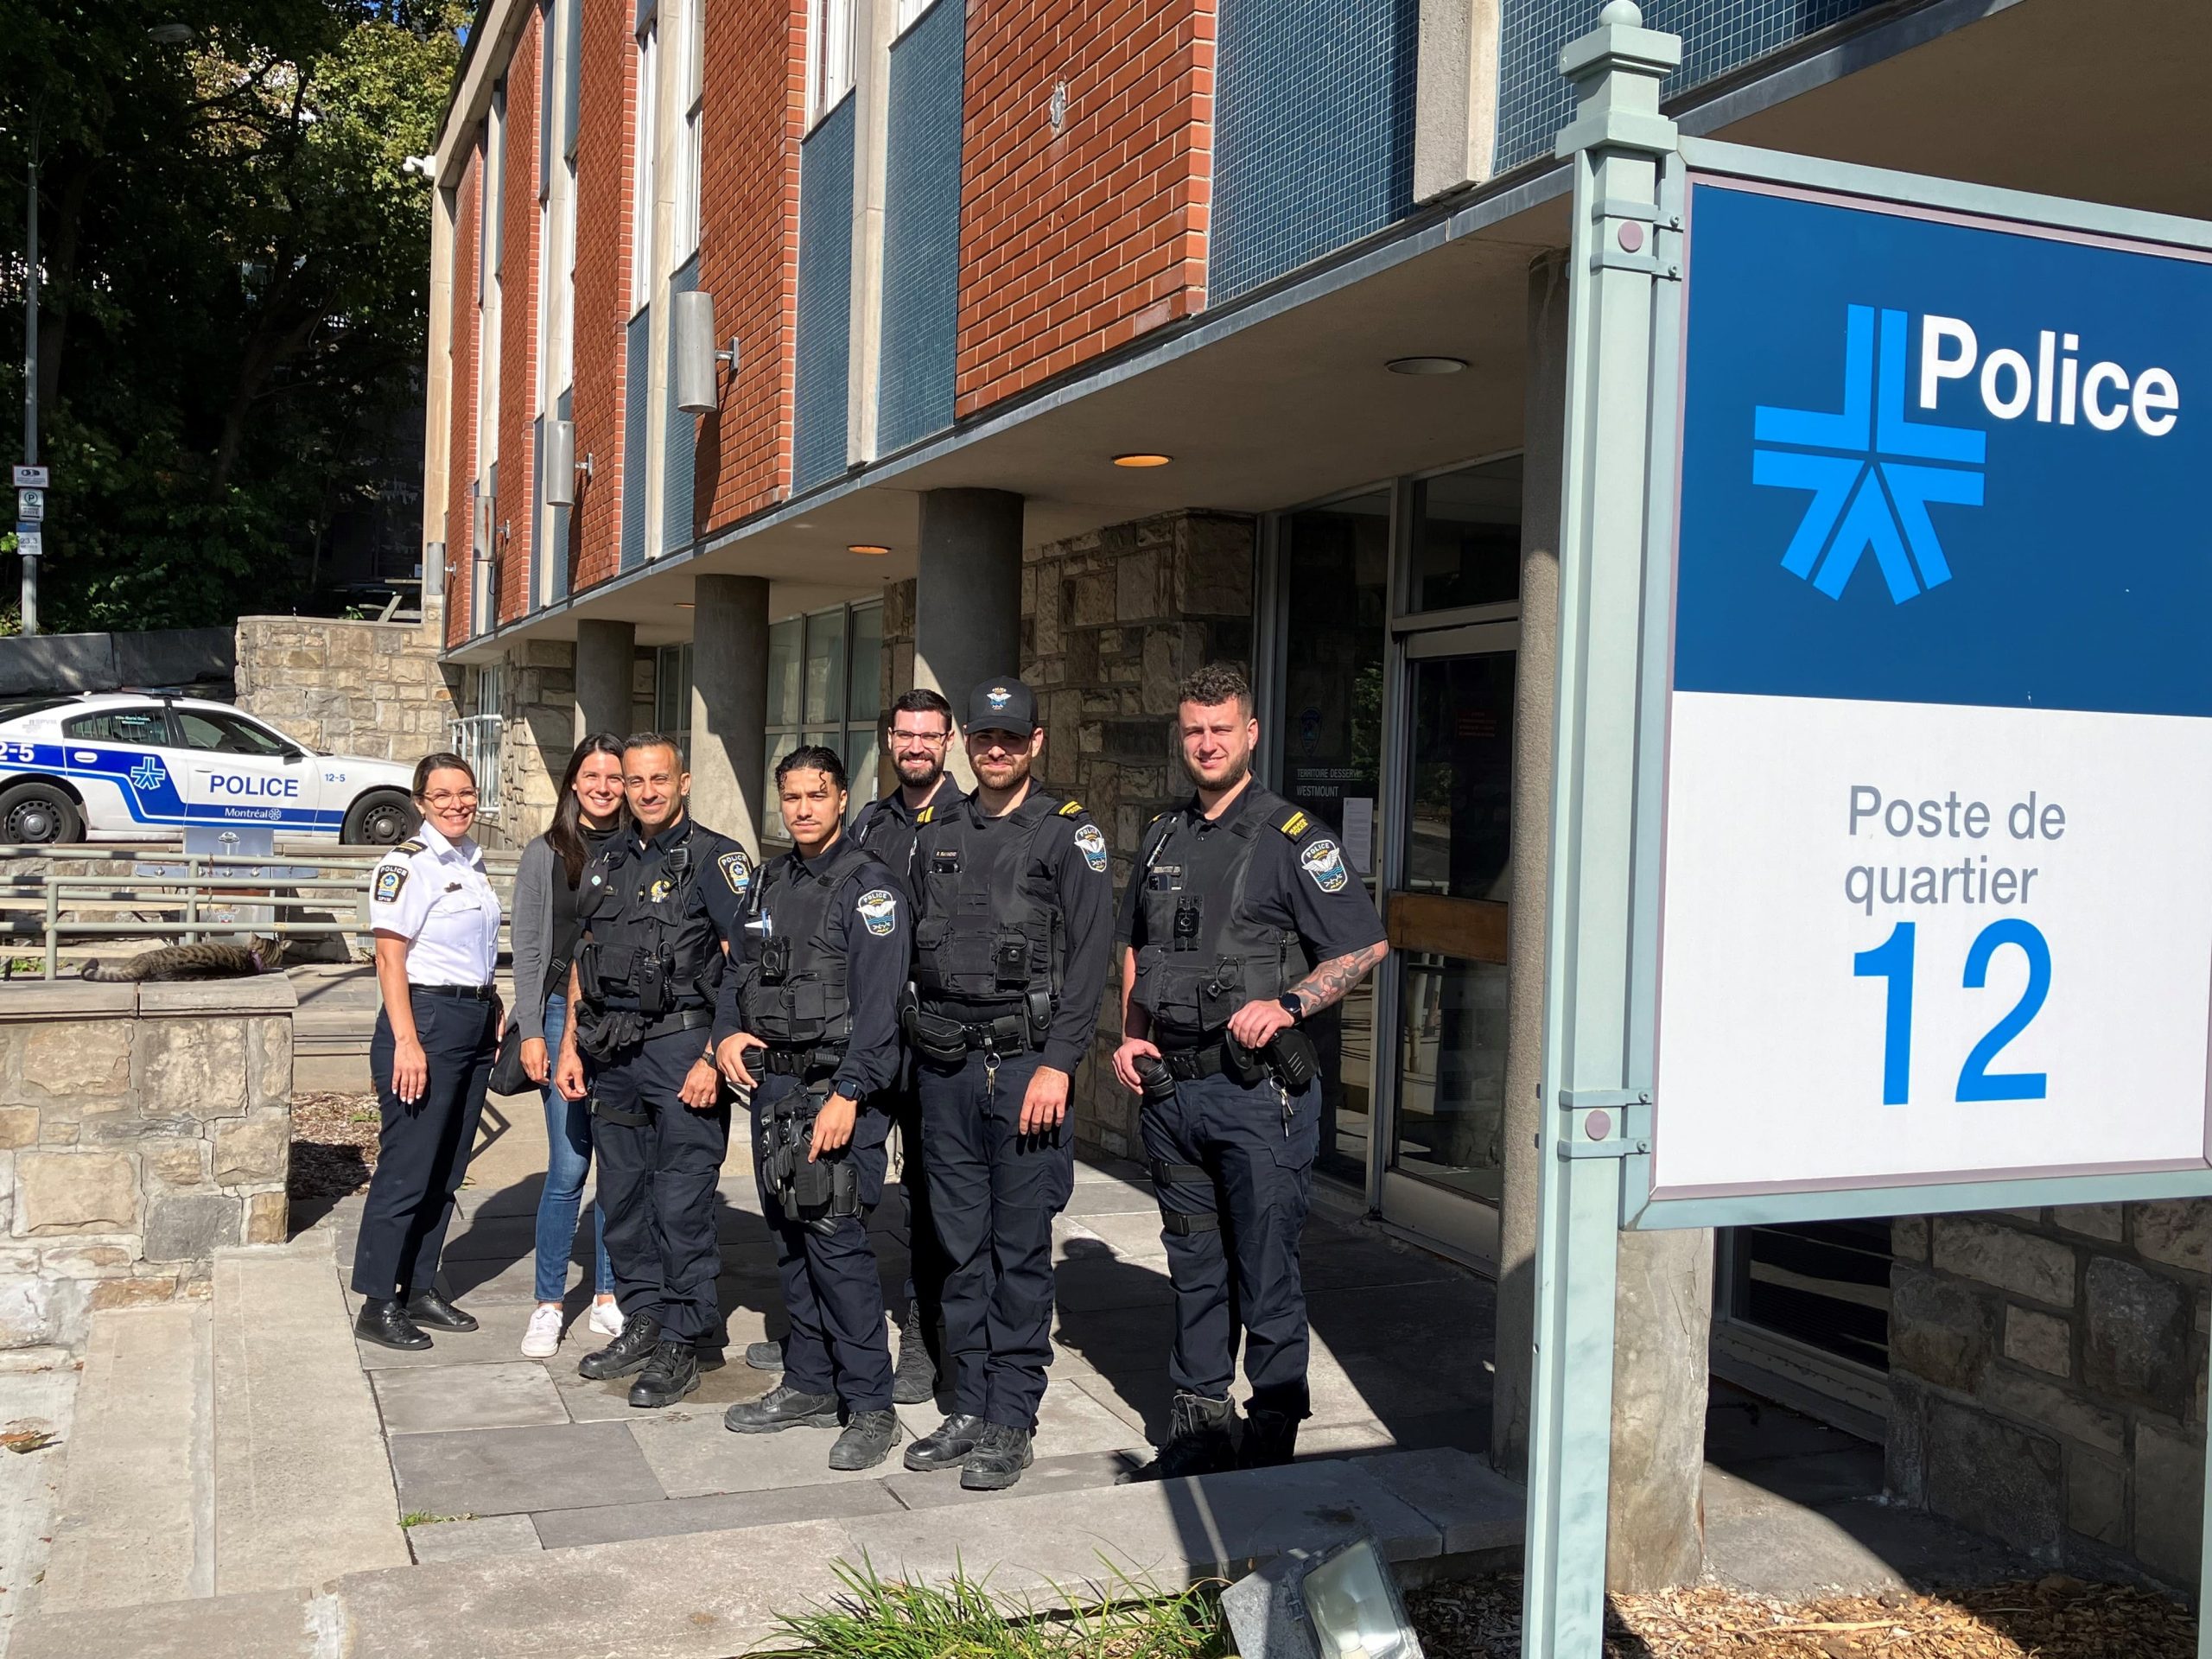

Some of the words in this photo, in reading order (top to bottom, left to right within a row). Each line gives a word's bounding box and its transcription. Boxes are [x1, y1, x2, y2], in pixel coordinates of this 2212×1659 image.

[1920, 314, 2180, 436] Police
[325, 773, 346, 783] 12-5
[1297, 768, 1329, 778] TERRITOIRE
[210, 775, 299, 798] POLICE
[1297, 786, 1338, 797] WESTMOUNT
[225, 807, 268, 819] Montréal
[1849, 785, 1991, 840] Poste
[2008, 791, 2067, 840] de
[1306, 842, 1331, 858] POLICE
[721, 855, 747, 866] POLICE
[380, 866, 408, 876] POLICE
[1845, 855, 2038, 917] quartier
[863, 893, 887, 903] POLICE
[1853, 918, 2052, 1105] 12
